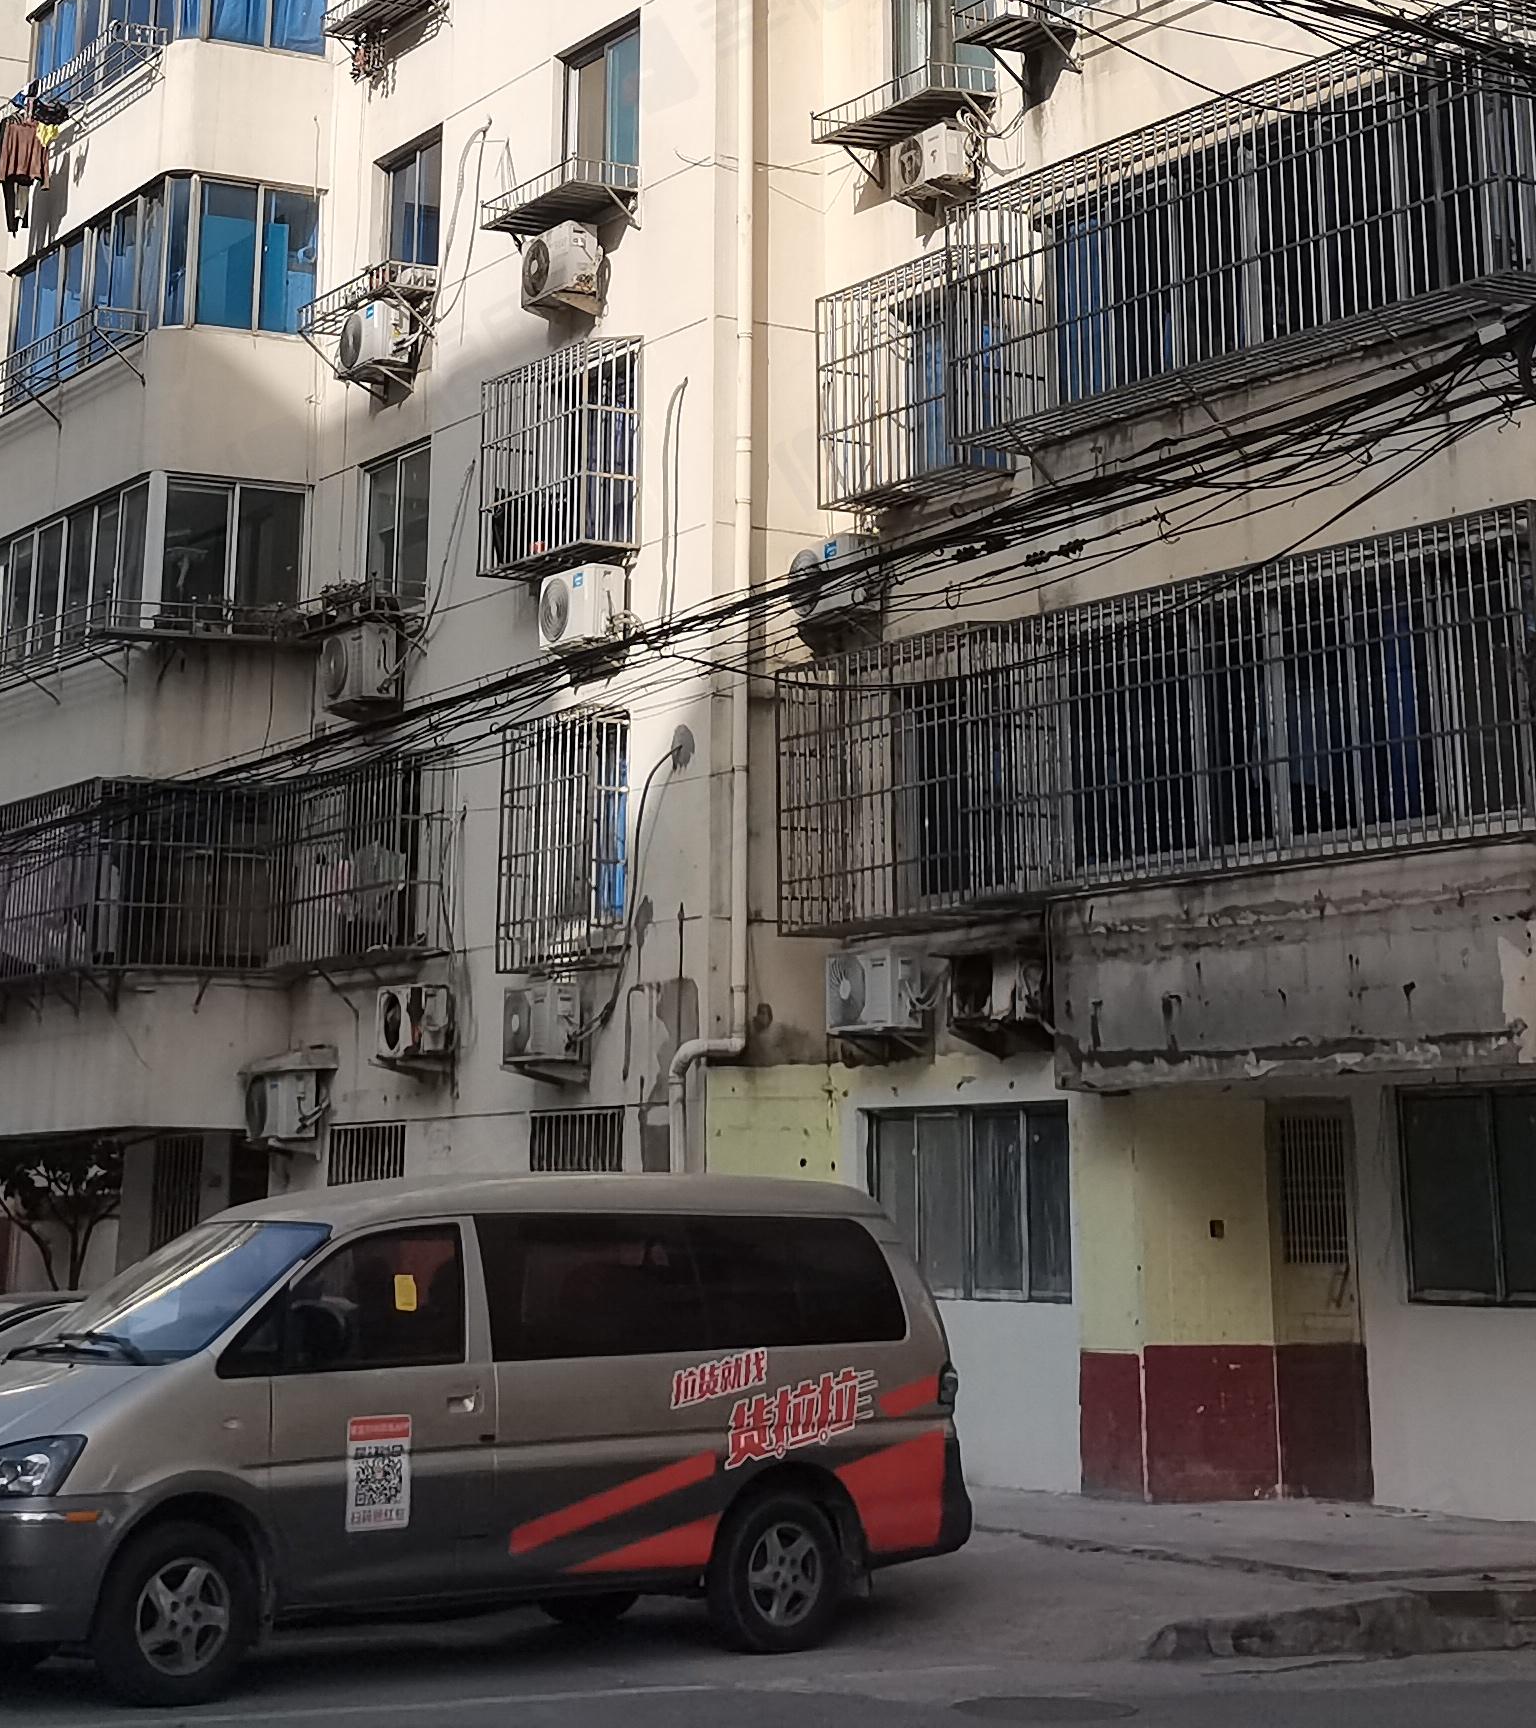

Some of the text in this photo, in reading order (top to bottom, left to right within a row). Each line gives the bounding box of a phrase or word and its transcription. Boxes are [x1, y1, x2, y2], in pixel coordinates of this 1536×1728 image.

[671, 1349, 767, 1409] 拉货就找
[725, 1367, 860, 1470] 货拉拉
